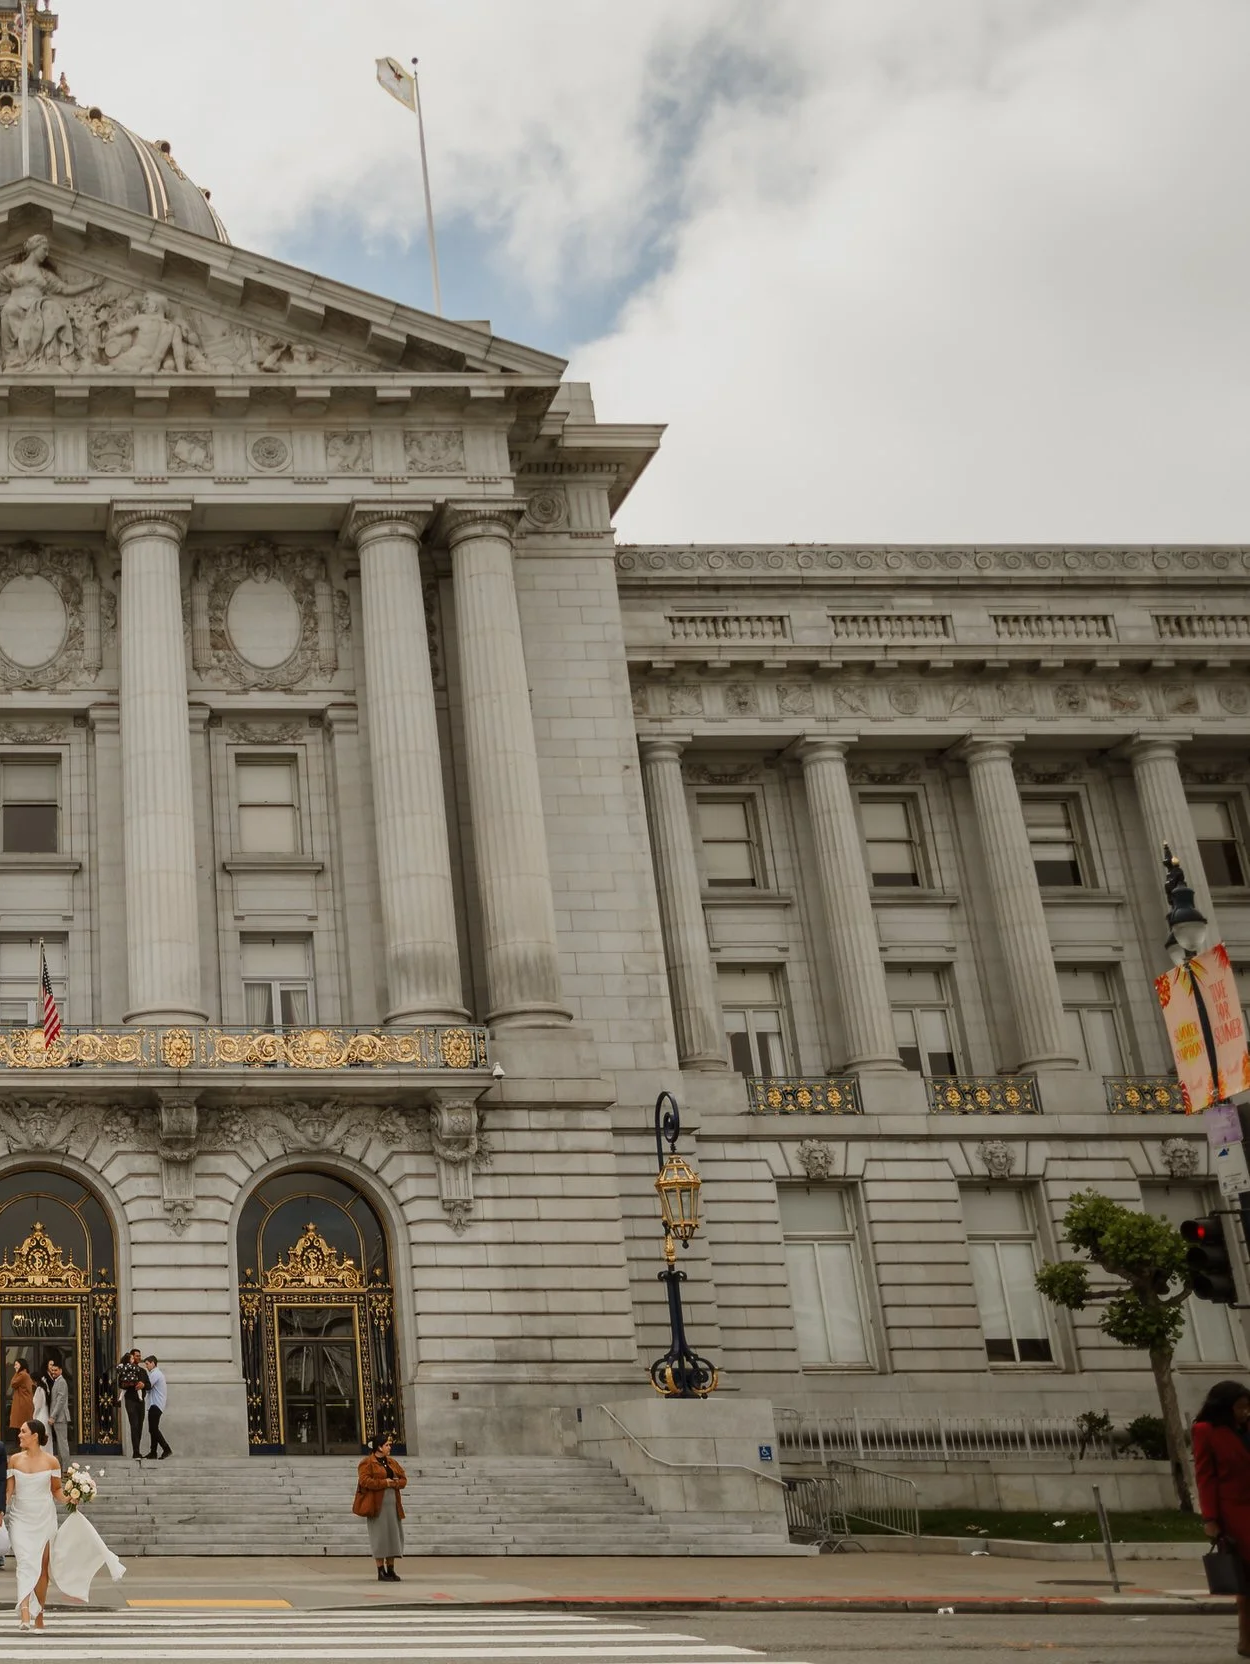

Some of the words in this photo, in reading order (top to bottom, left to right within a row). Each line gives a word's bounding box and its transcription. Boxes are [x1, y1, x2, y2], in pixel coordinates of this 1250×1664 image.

[1208, 979, 1228, 1003] TIME
[1215, 1001, 1231, 1022] FOR
[1214, 1017, 1243, 1046] SUMMER
[38, 1318, 65, 1328] HALL
